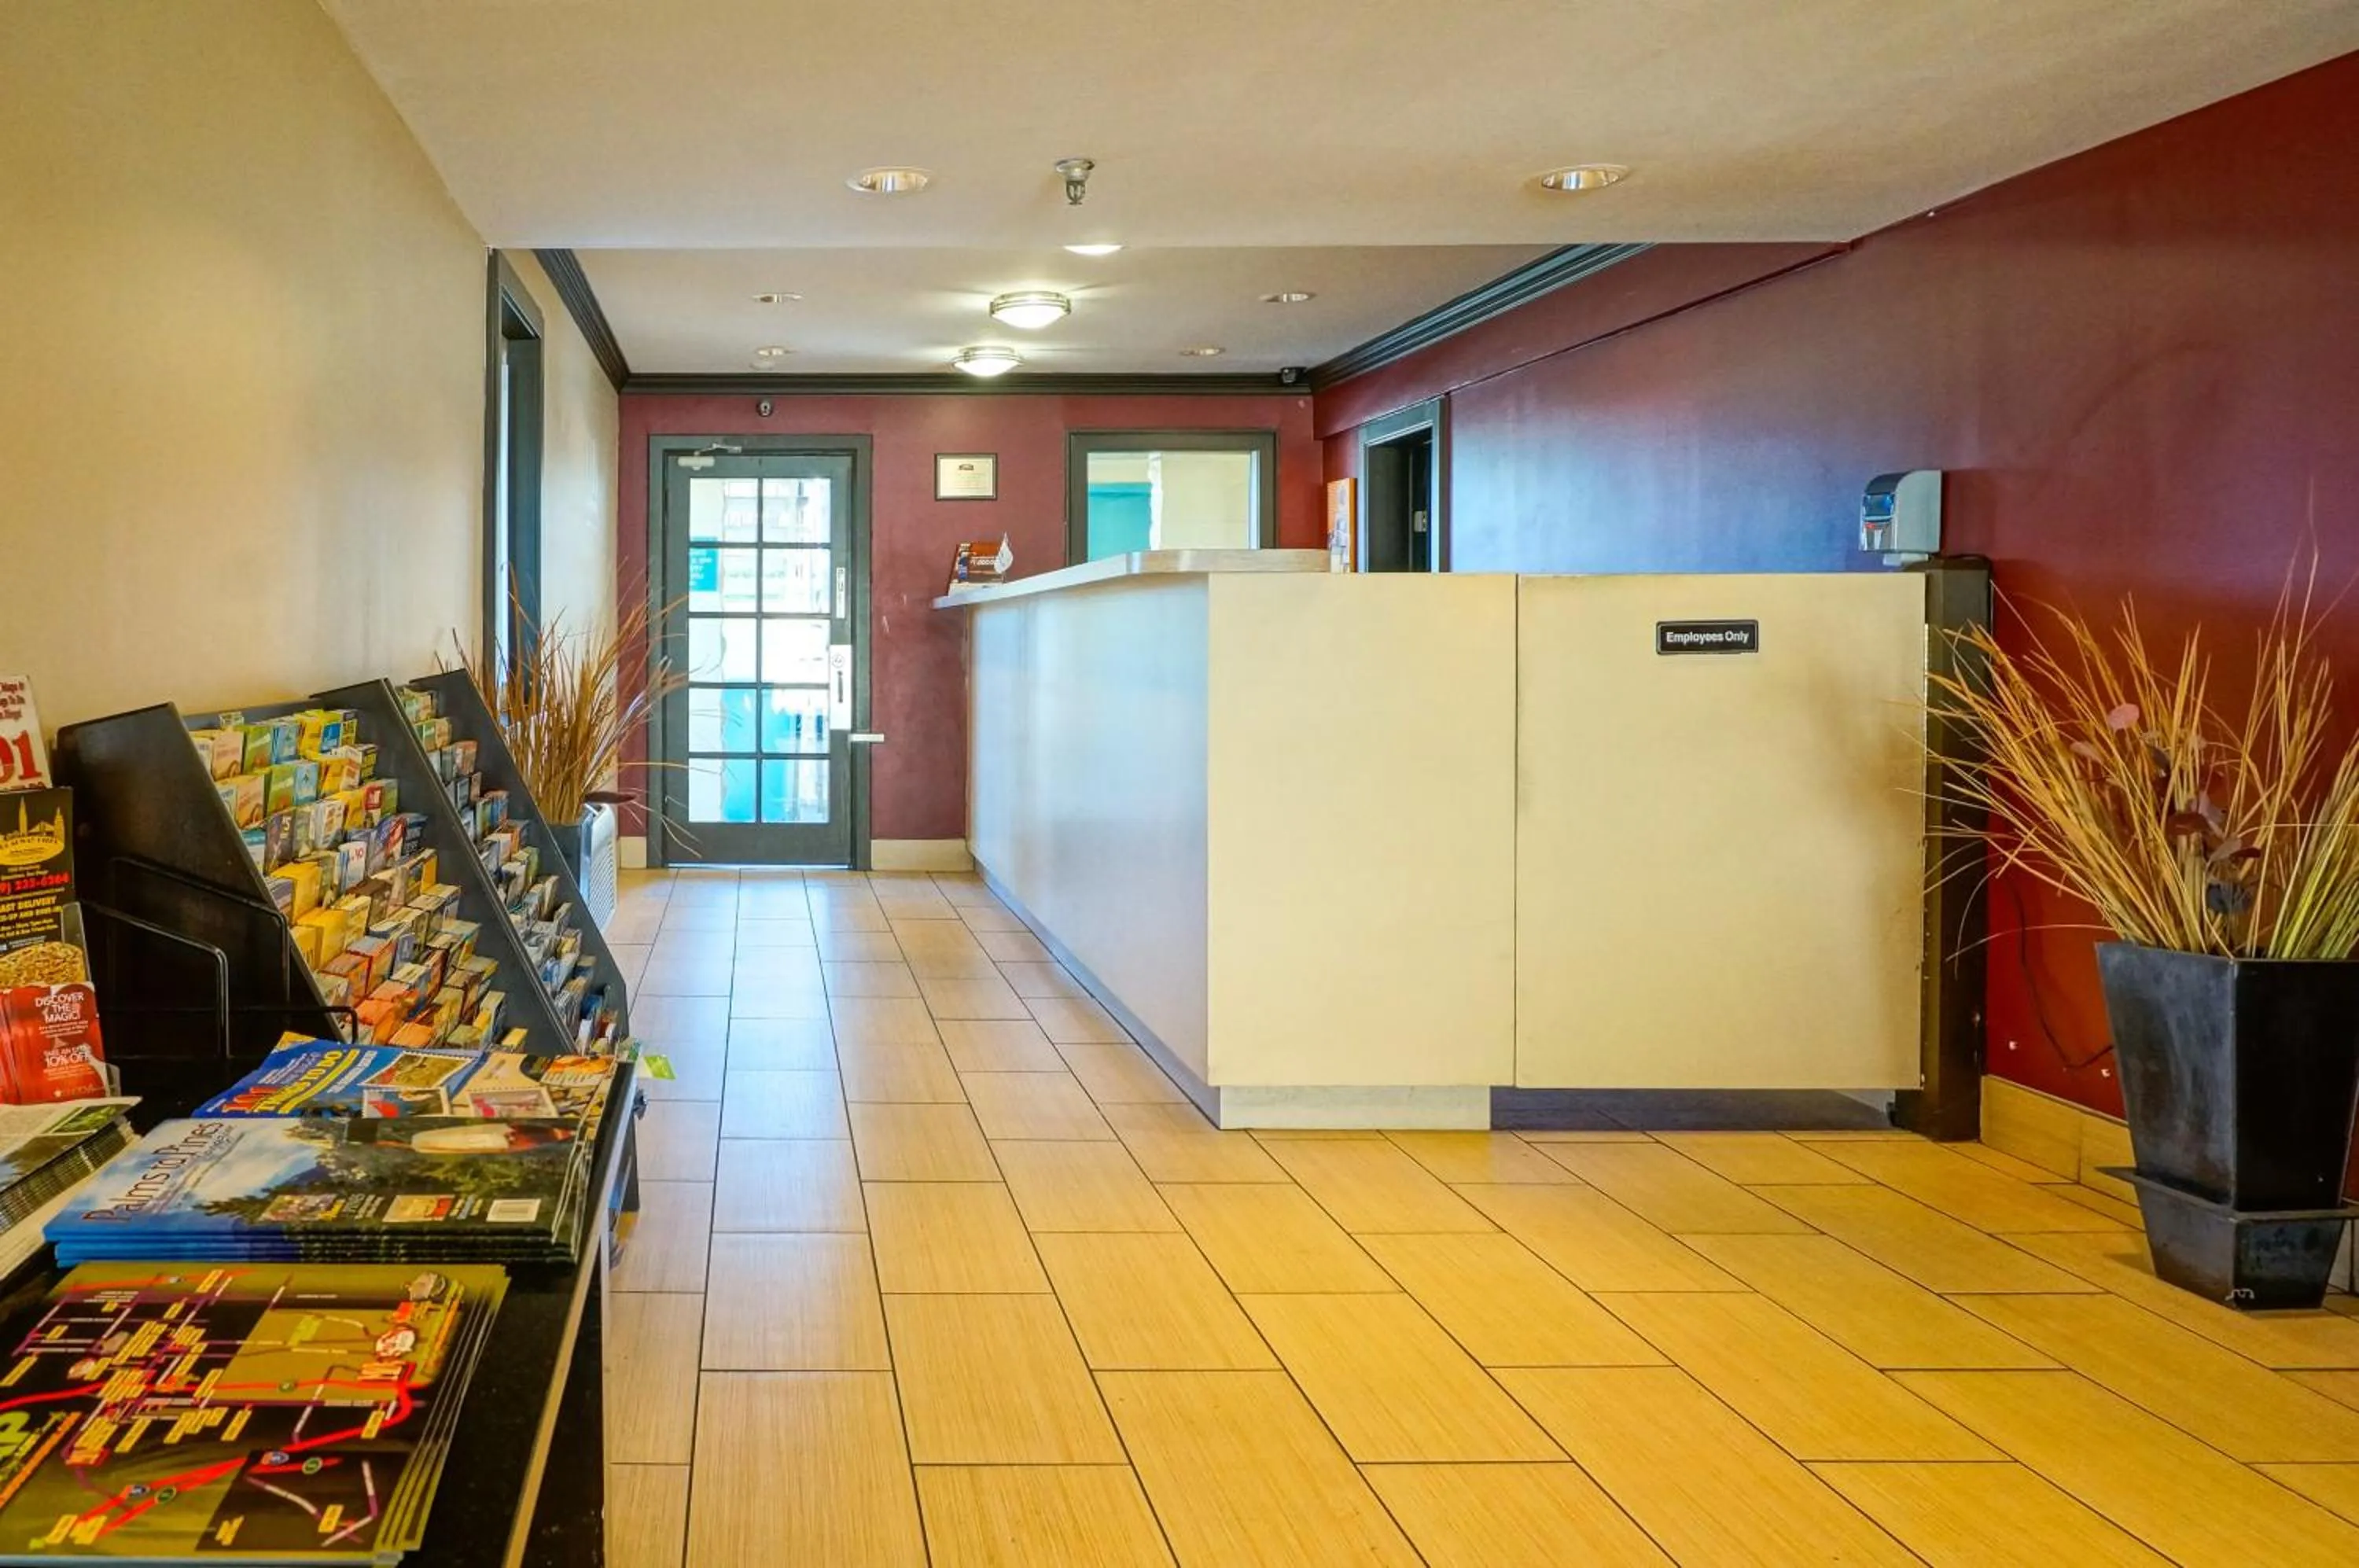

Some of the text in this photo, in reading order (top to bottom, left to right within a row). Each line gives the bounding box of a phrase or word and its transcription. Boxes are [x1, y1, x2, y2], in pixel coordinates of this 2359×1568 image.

[1665, 630, 1750, 646] Employees Only
[35, 992, 85, 1007] DISCOVER
[52, 1003, 72, 1014] THE
[152, 1121, 224, 1155] Pines
[150, 1158, 186, 1170] to
[81, 1172, 171, 1222] Palms
